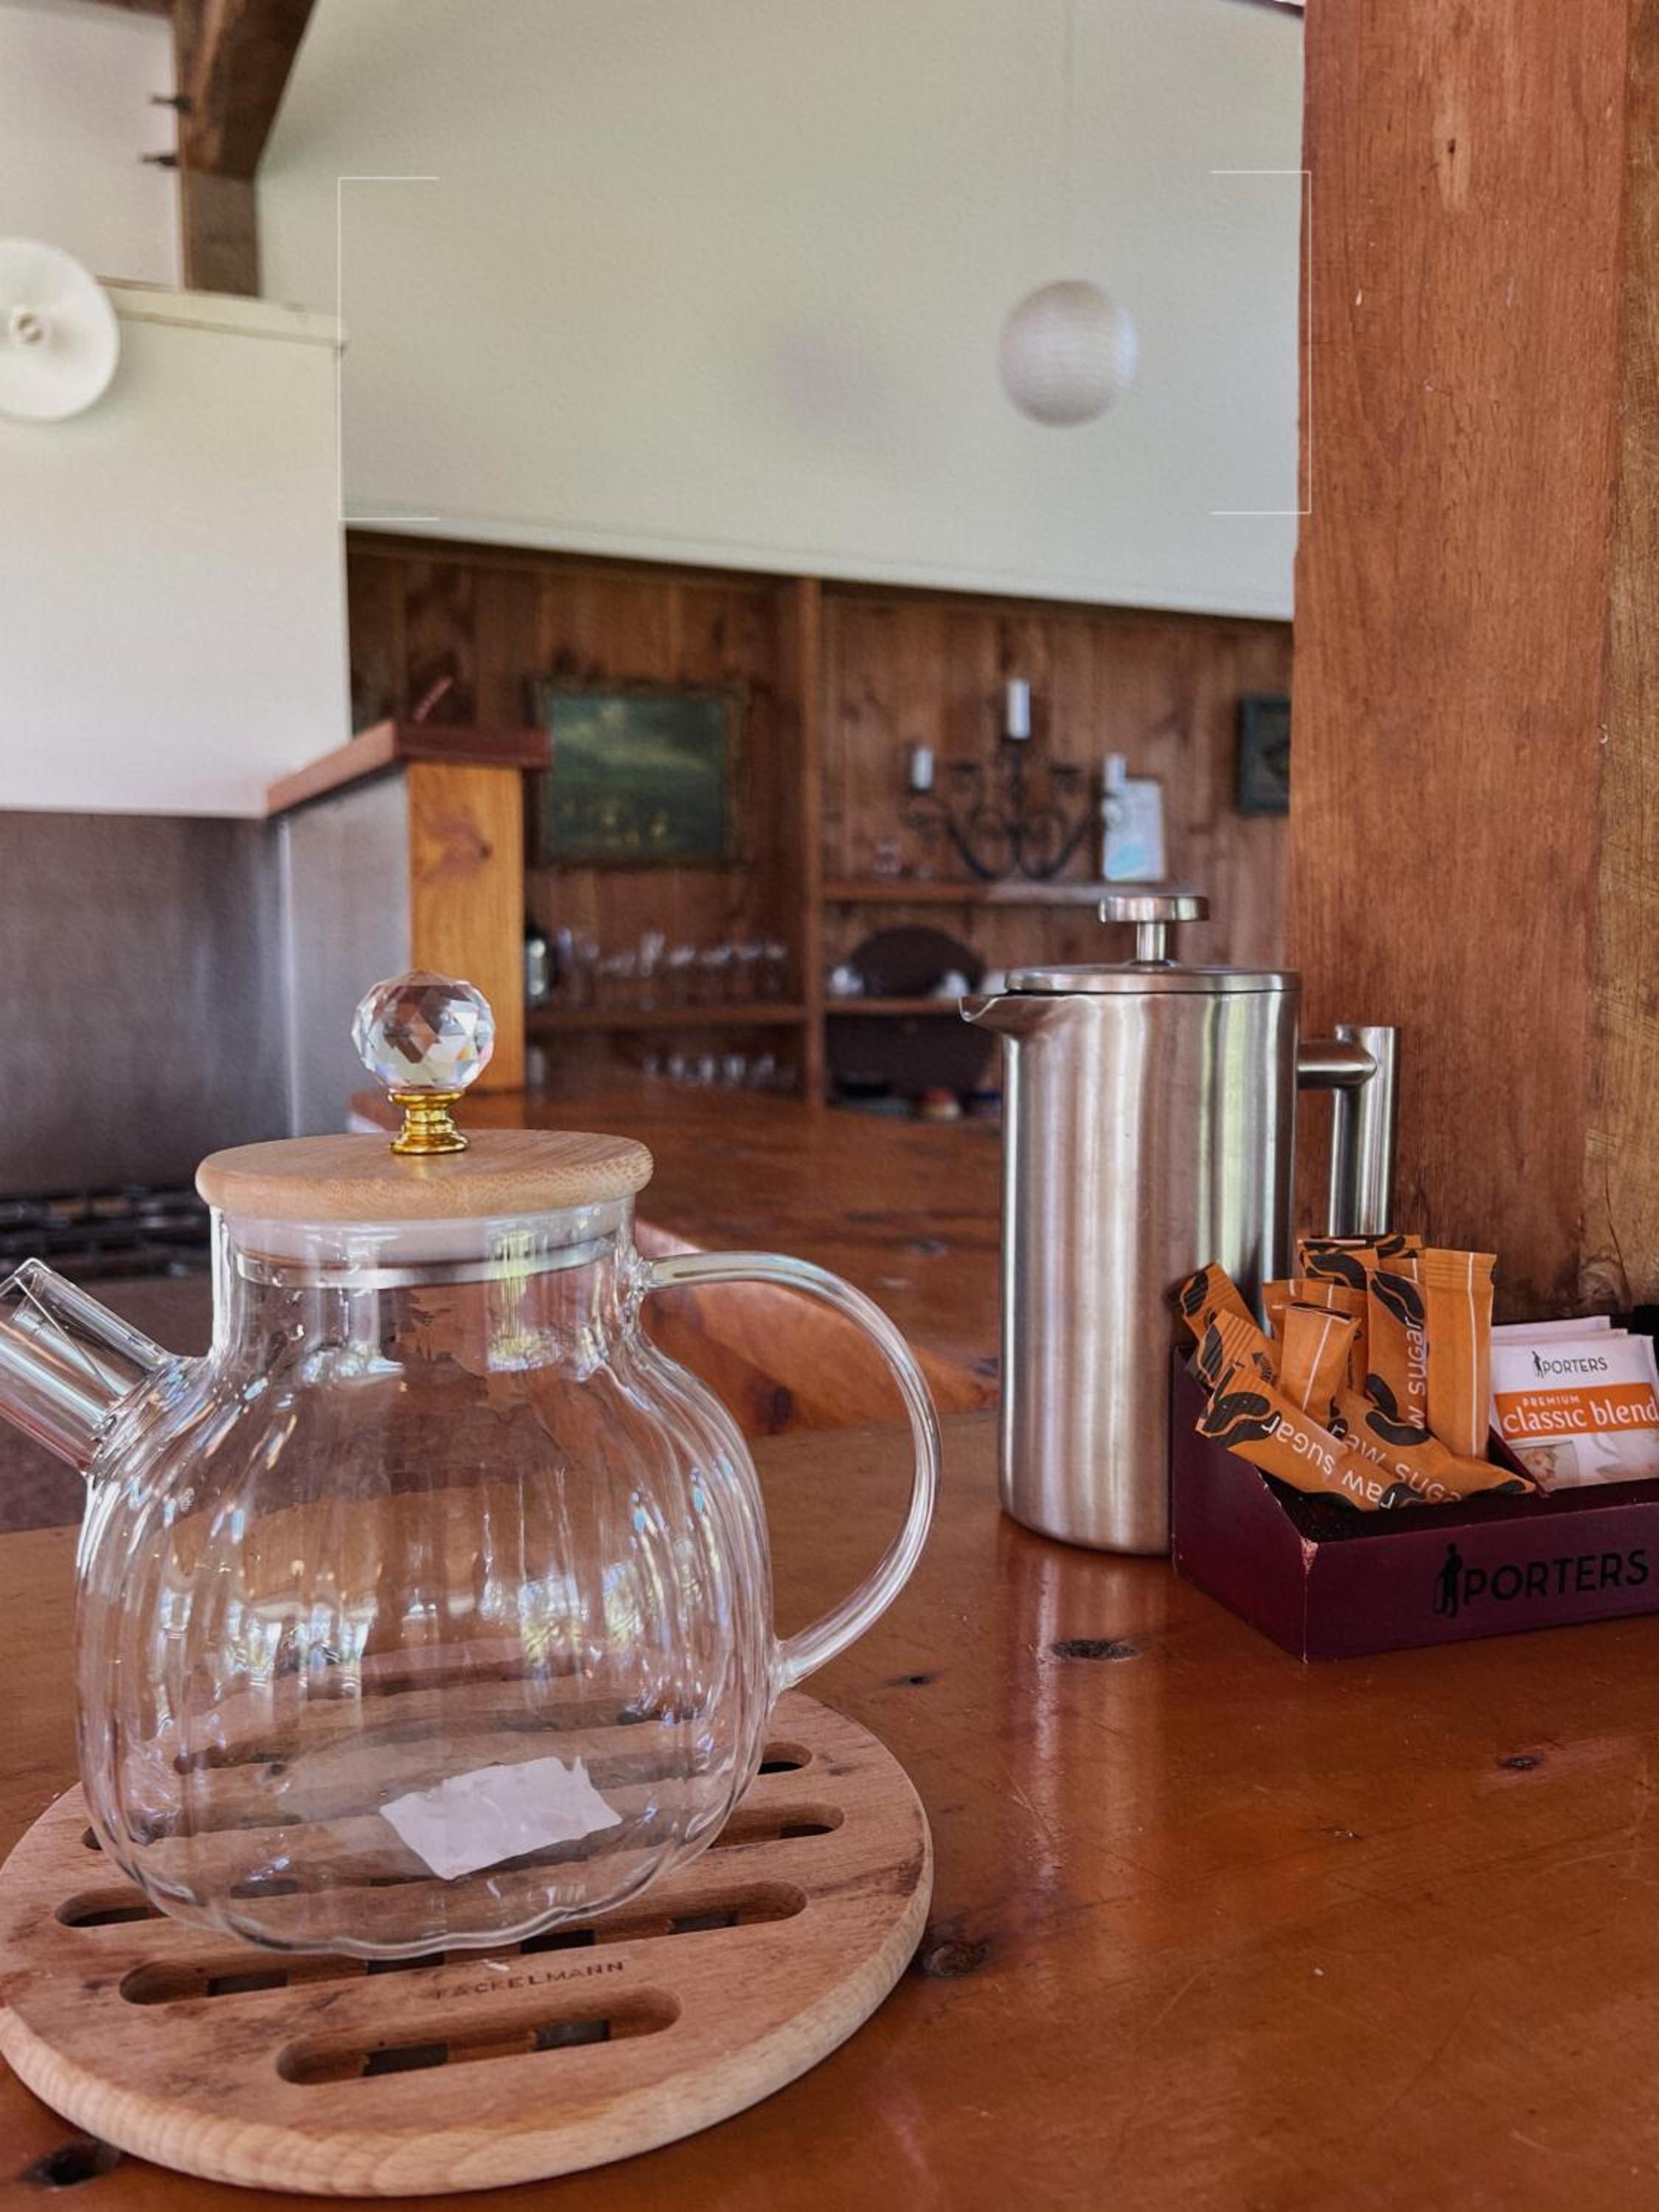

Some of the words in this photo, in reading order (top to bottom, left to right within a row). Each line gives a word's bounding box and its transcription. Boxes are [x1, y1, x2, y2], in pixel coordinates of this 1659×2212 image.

[1542, 1356, 1609, 1376] PORTERS
[1503, 1405, 1587, 1434] classic
[1589, 1395, 1659, 1427] blend
[1522, 1394, 1581, 1408] PREMIUM
[1342, 1470, 1396, 1509] raw
[1462, 1548, 1649, 1605] PORTERS
